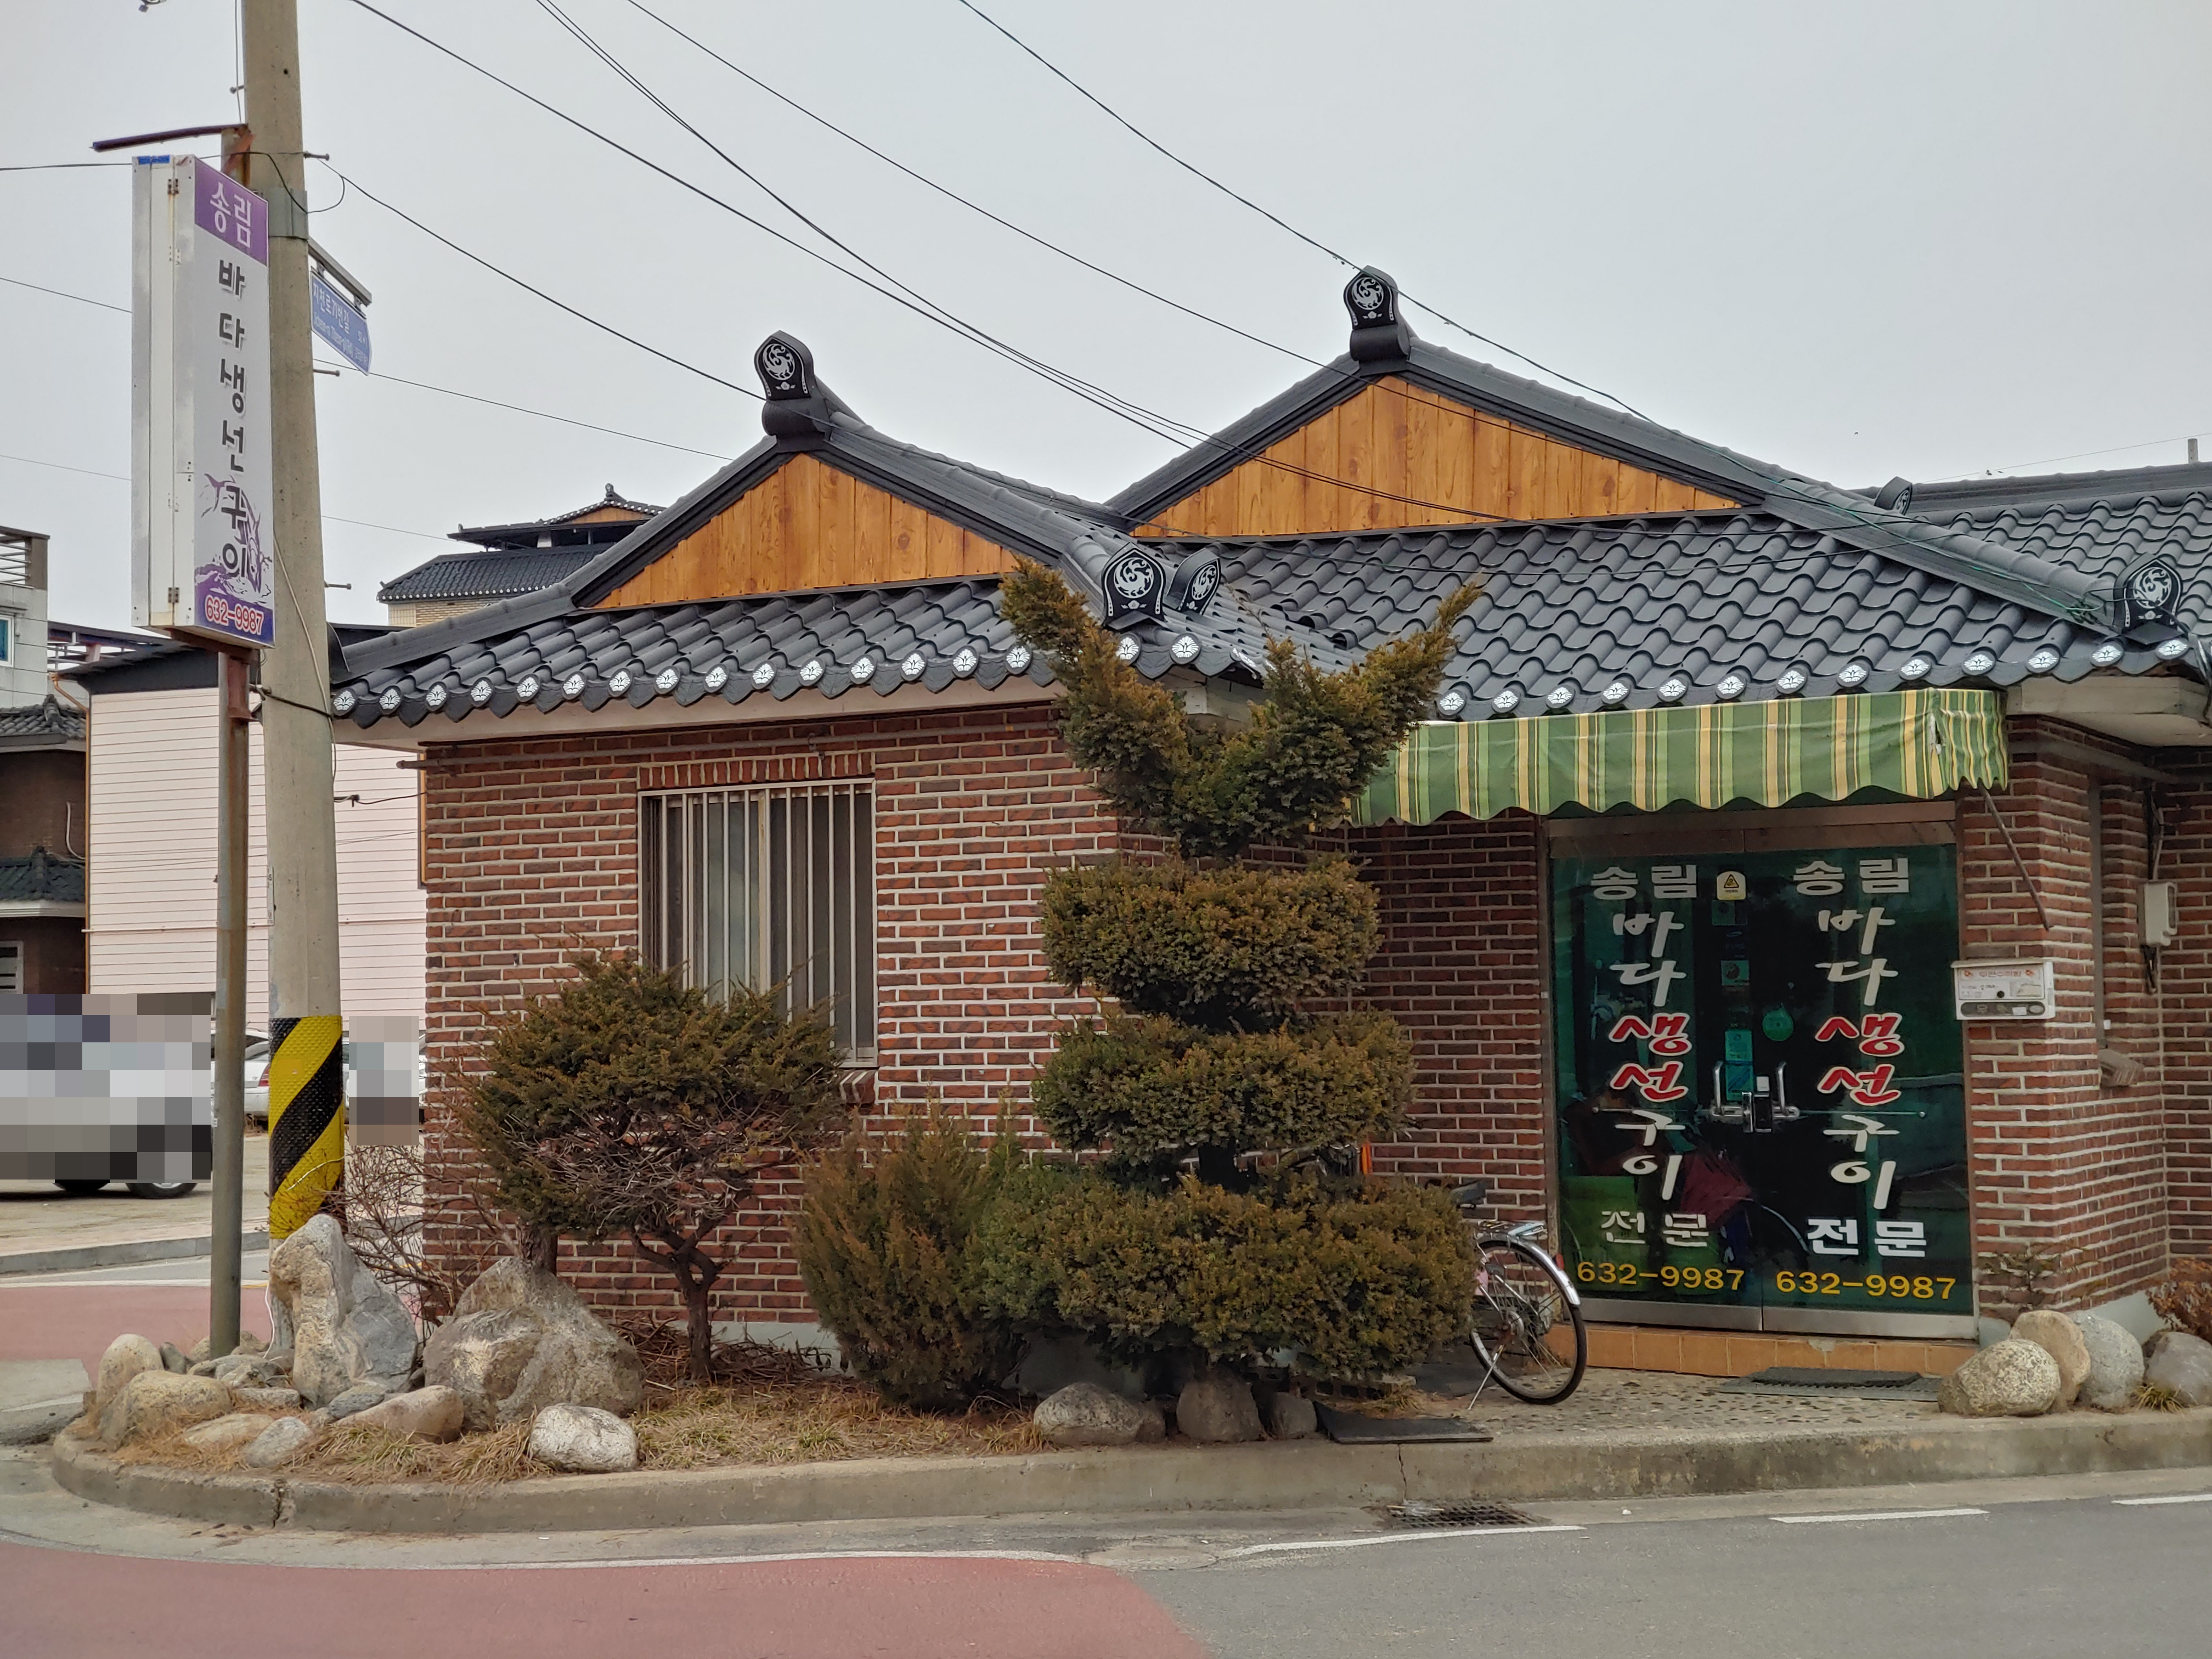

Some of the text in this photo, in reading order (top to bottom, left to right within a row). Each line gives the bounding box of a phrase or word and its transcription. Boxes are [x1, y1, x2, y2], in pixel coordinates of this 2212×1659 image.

[210, 182, 251, 248] 송림
[205, 594, 264, 635] 632-9987
[1592, 865, 1696, 900] 송림
[1793, 858, 1909, 895] 송림
[1601, 1210, 1709, 1247] 전문
[1807, 1218, 1927, 1257] 전문
[1577, 1262, 1744, 1291] 632-9987
[1776, 1271, 1956, 1300] 632-9987
